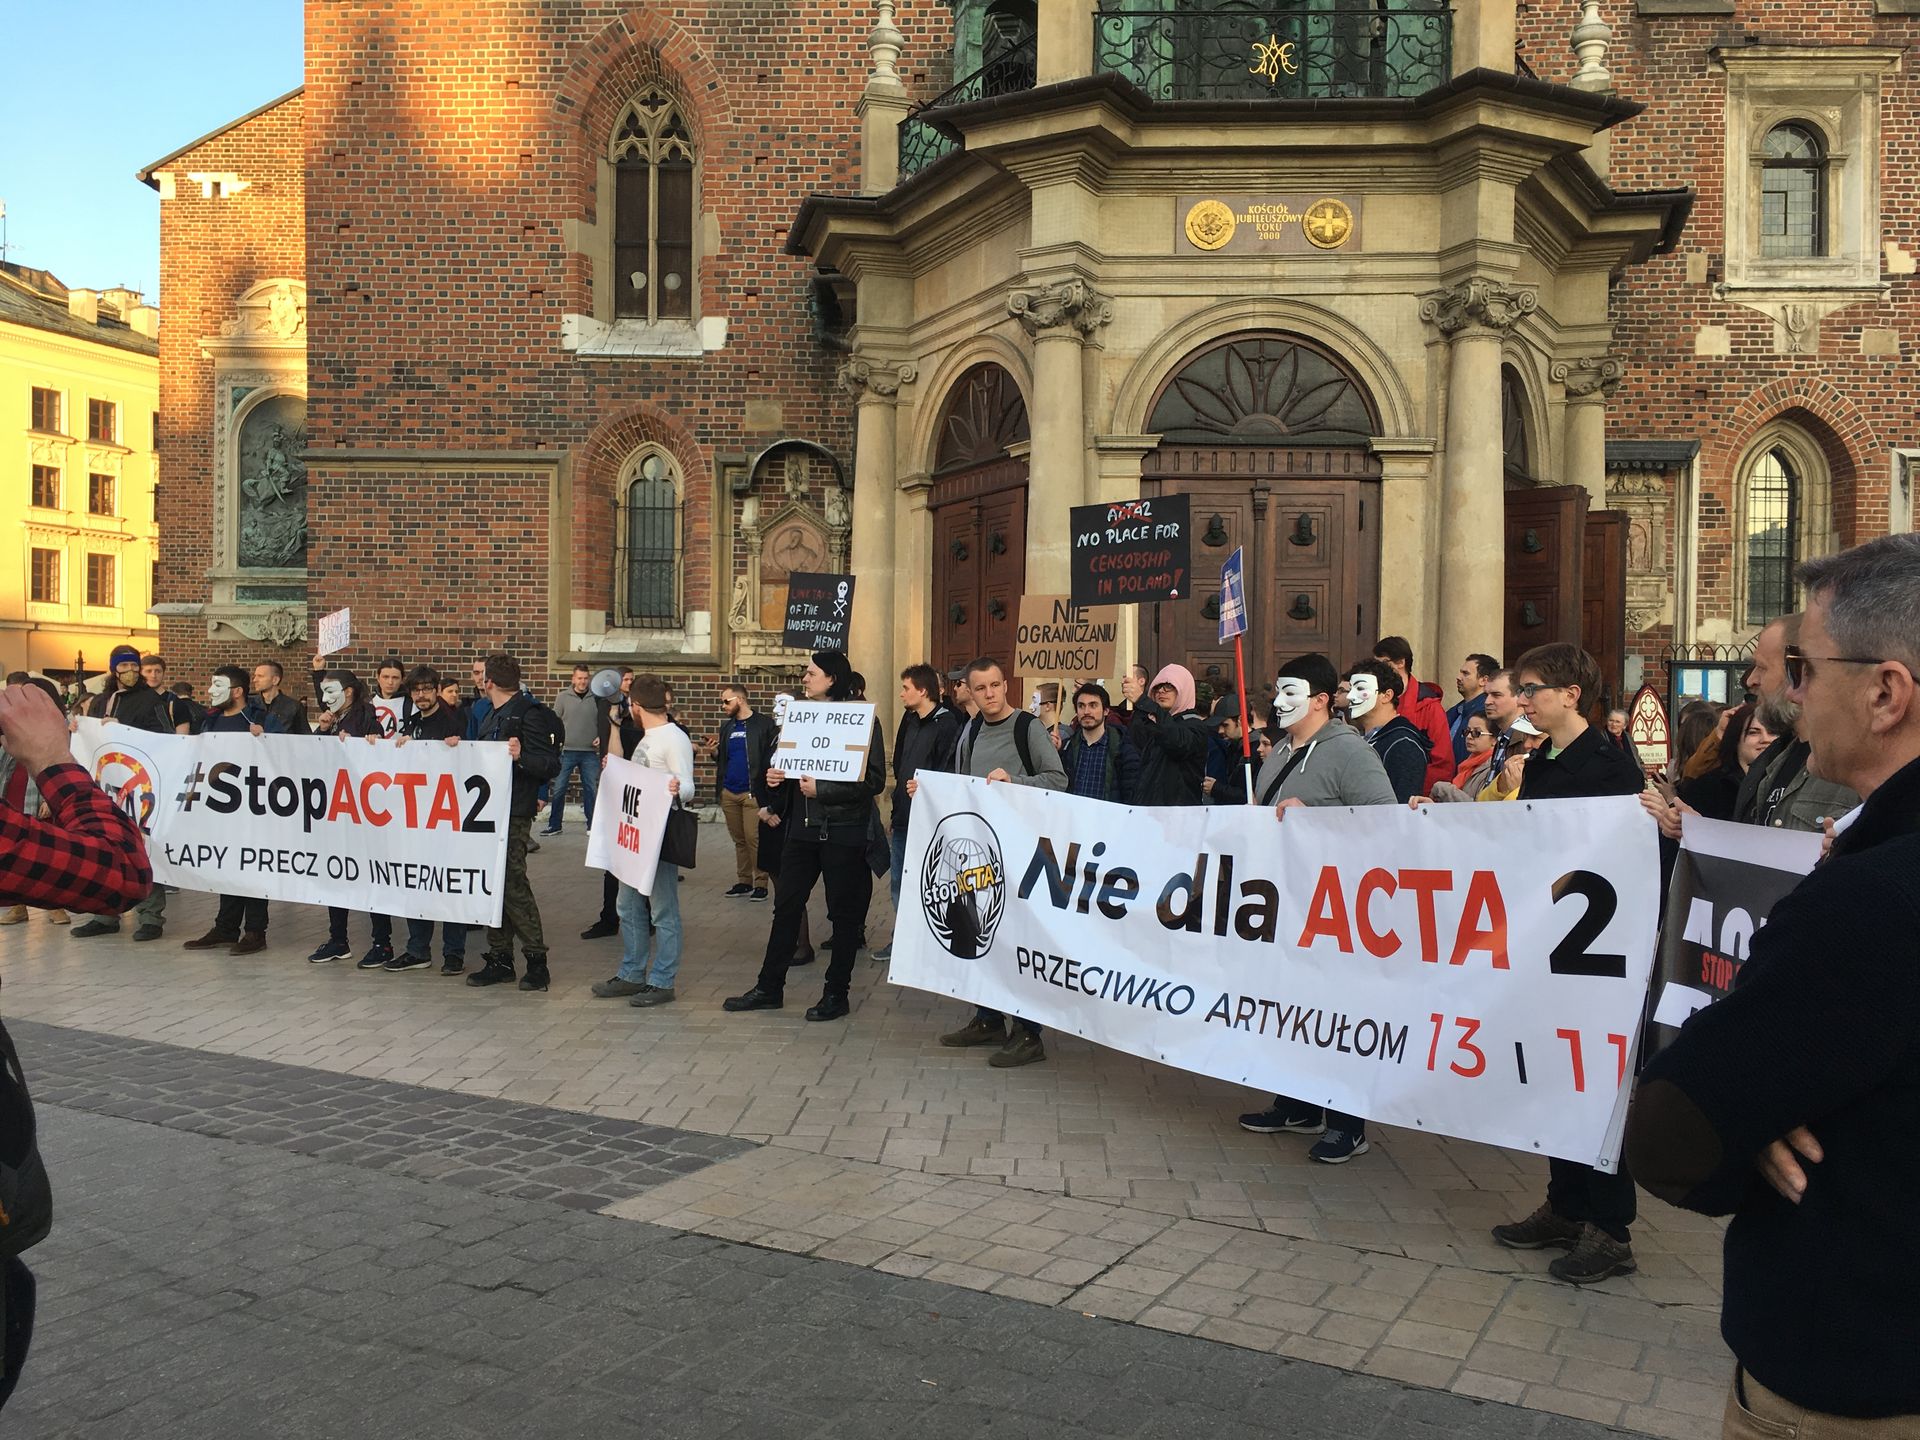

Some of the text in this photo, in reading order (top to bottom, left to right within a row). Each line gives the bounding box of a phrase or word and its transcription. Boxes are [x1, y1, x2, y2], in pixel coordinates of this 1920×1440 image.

[1236, 214, 1303, 224] JUBILEUSZOWY
[1249, 203, 1289, 214] KOŚCIÓŁ
[1256, 223, 1282, 232] ROKU
[1259, 232, 1280, 240] 2000
[1077, 522, 1180, 548] NO PLACE FOR
[1089, 549, 1172, 573] CENSORSHIP
[1098, 568, 1184, 596] IN POLAND!
[789, 604, 819, 615] OF THE
[1052, 599, 1090, 624] NIE
[787, 619, 843, 632] INDEPENDENT
[1017, 622, 1117, 644] OGRANICZANIU
[813, 634, 842, 649] MEDIA
[1019, 646, 1099, 670] WOLNOŚCI
[788, 711, 865, 725] ŁAPY PRECZ
[811, 736, 830, 749] OD
[780, 758, 849, 773] INTERNETU
[176, 761, 496, 833] #StopACTA2
[622, 784, 642, 818] NIE
[617, 821, 640, 854] ACTA
[165, 842, 228, 869] ŁAPY
[240, 847, 318, 877] PRECZ
[327, 855, 359, 881] OD
[1017, 836, 1139, 920] Nie
[1156, 852, 1280, 943] dla
[1296, 865, 1510, 970] ACTA
[1549, 870, 1627, 978] 2
[1701, 952, 1733, 991] STOP
[1016, 946, 1195, 1016] PRZECIWKO
[1204, 992, 1409, 1064] ARTYKUŁOM
[1426, 1013, 1487, 1078] 13
